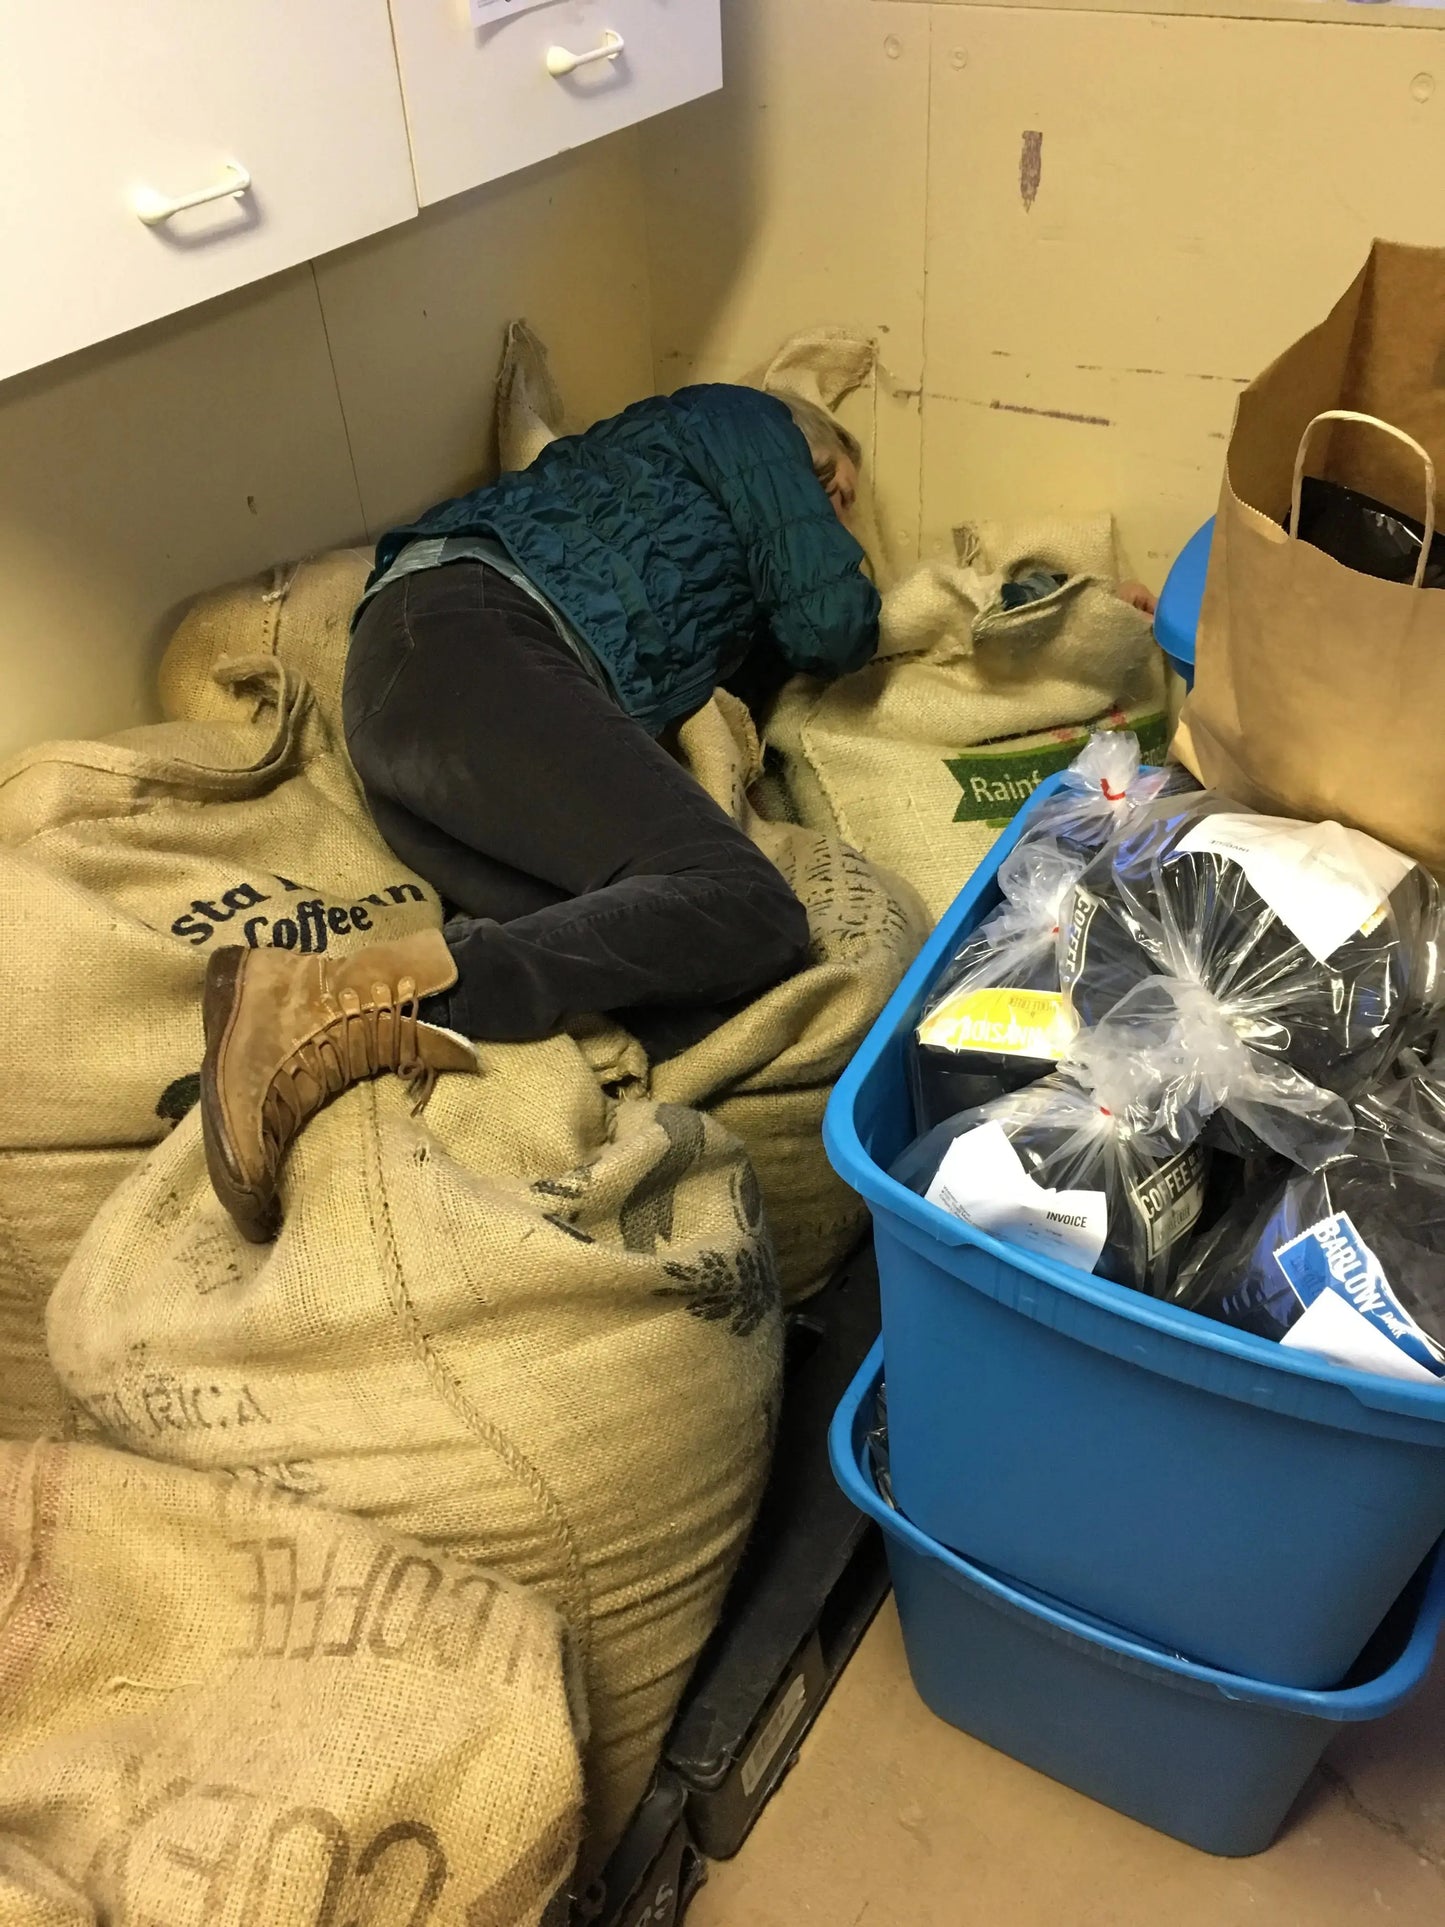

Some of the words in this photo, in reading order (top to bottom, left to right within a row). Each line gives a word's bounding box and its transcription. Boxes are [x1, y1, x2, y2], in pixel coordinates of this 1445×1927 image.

[243, 899, 373, 953] Coffee
[1140, 1161, 1191, 1219] COFFEE
[1046, 1211, 1087, 1228] INVOICE
[1315, 1220, 1386, 1313] BARLOW
